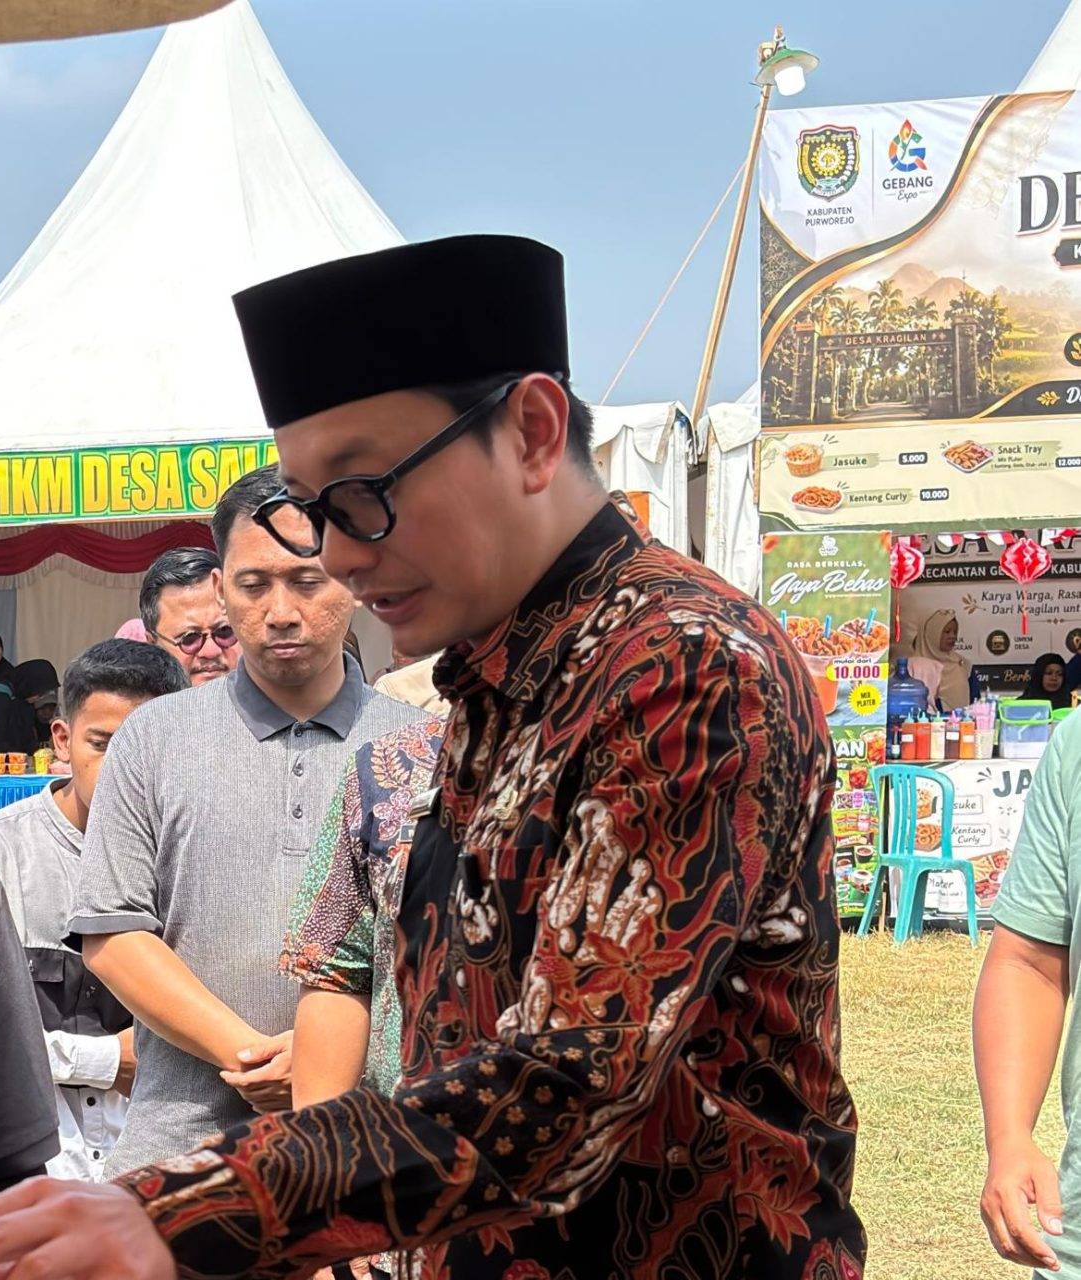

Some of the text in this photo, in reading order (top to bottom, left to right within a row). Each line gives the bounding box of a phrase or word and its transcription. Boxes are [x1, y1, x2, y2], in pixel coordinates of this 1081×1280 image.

[882, 176, 933, 190] GEBANG
[897, 191, 918, 202] Expo
[807, 207, 853, 216] KABUPATEN
[805, 216, 855, 226] PURWOREJO
[845, 333, 927, 345] DESA KRAGILAN
[998, 445, 1043, 455] Snack Tray
[833, 453, 925, 467] Jasuke 5.000
[82, 450, 186, 514] DESA
[850, 490, 948, 503] Kentang Curly 10.000
[919, 566, 988, 578] KECAMATAN
[767, 569, 890, 606] Gaya Bebas
[982, 590, 1011, 603] Karya
[992, 604, 1014, 614] Dari
[834, 665, 880, 679] 10.000
[953, 799, 977, 809] suke
[952, 826, 986, 836] Kentang
[957, 835, 981, 844] Curly
